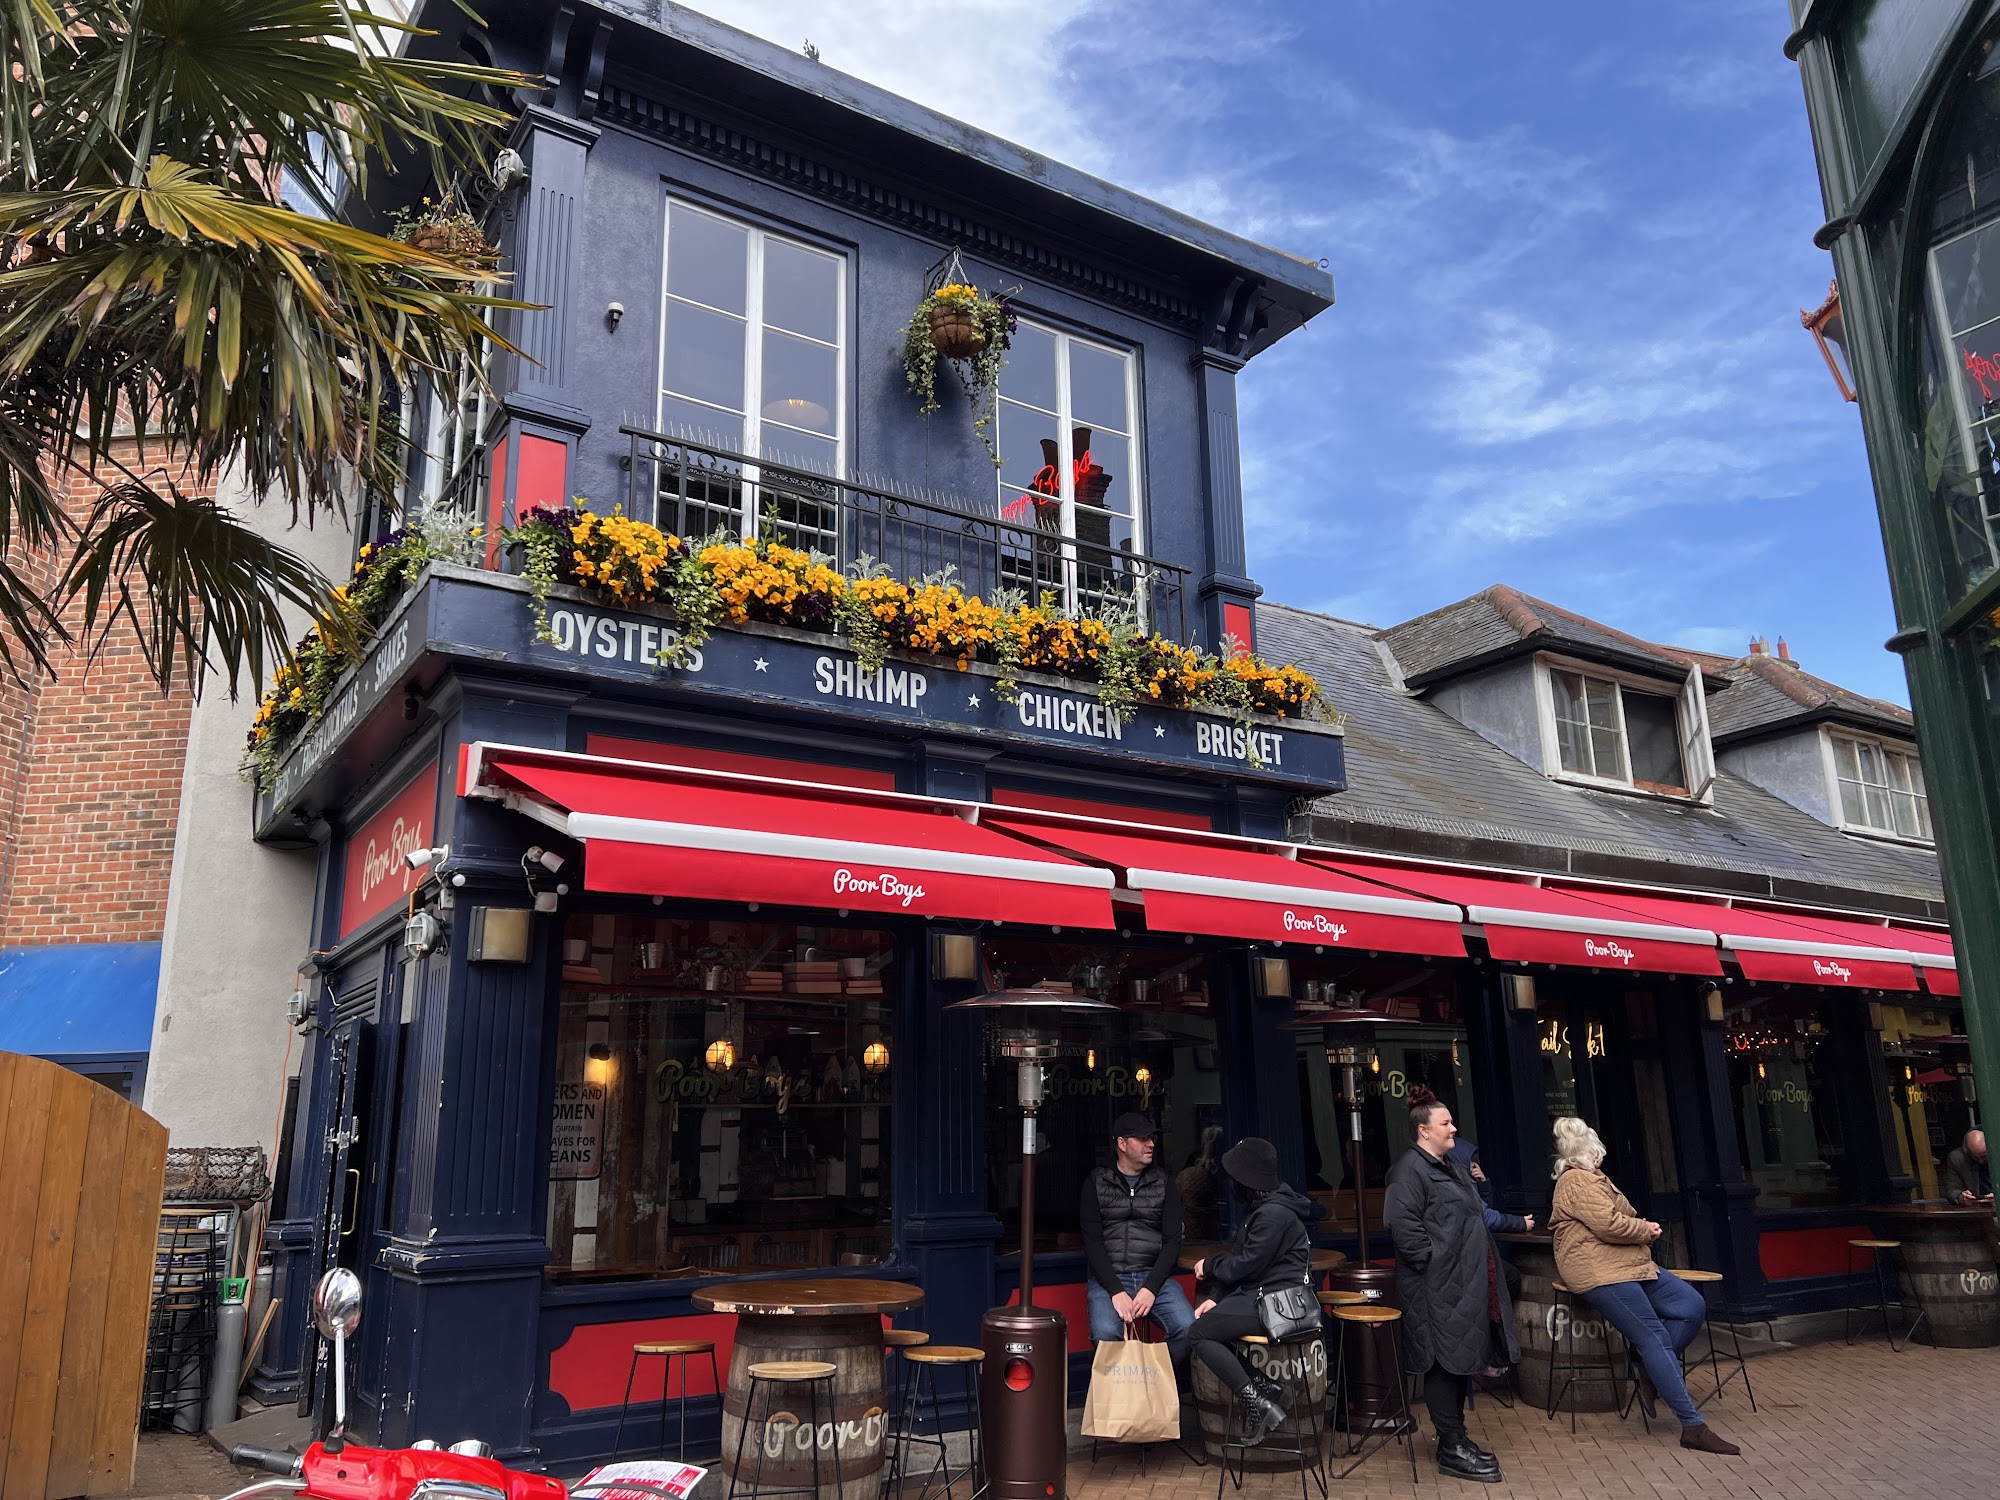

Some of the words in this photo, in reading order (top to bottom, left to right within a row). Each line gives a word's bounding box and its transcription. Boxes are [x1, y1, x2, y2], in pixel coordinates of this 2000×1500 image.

[323, 681, 359, 751] COCKTAILS
[374, 620, 408, 692] SHAKES
[552, 610, 704, 672] OYSTERS
[816, 656, 927, 708] SHRIMP
[1020, 692, 1122, 740] CHICKEN
[1197, 721, 1283, 765] BRISKET
[362, 838, 390, 902] Poor
[390, 817, 422, 892] Boys
[833, 868, 880, 894] Poor
[879, 873, 926, 907] Boys
[1283, 910, 1315, 931] Poor
[1313, 914, 1347, 942] Boys
[1585, 938, 1610, 957] Poor
[1607, 941, 1635, 965] Boys
[1813, 959, 1833, 976] Poor
[1830, 961, 1851, 982] Boys
[555, 1083, 578, 1100] ERS
[582, 1088, 602, 1100] AND
[654, 1059, 733, 1103] Poor
[732, 1062, 812, 1115] Boys
[1050, 1064, 1106, 1100] Poor
[1106, 1066, 1165, 1111] Boys
[1756, 1080, 1785, 1105] Poor
[1783, 1080, 1815, 1113] Boys
[1906, 1084, 1929, 1105] Poor
[552, 1104, 595, 1120] OMEN
[550, 1150, 591, 1163] EANS
[552, 1137, 574, 1146] AVES
[577, 1137, 596, 1146] FOR
[1242, 1344, 1312, 1381] Poor
[763, 1411, 862, 1458] Poor
